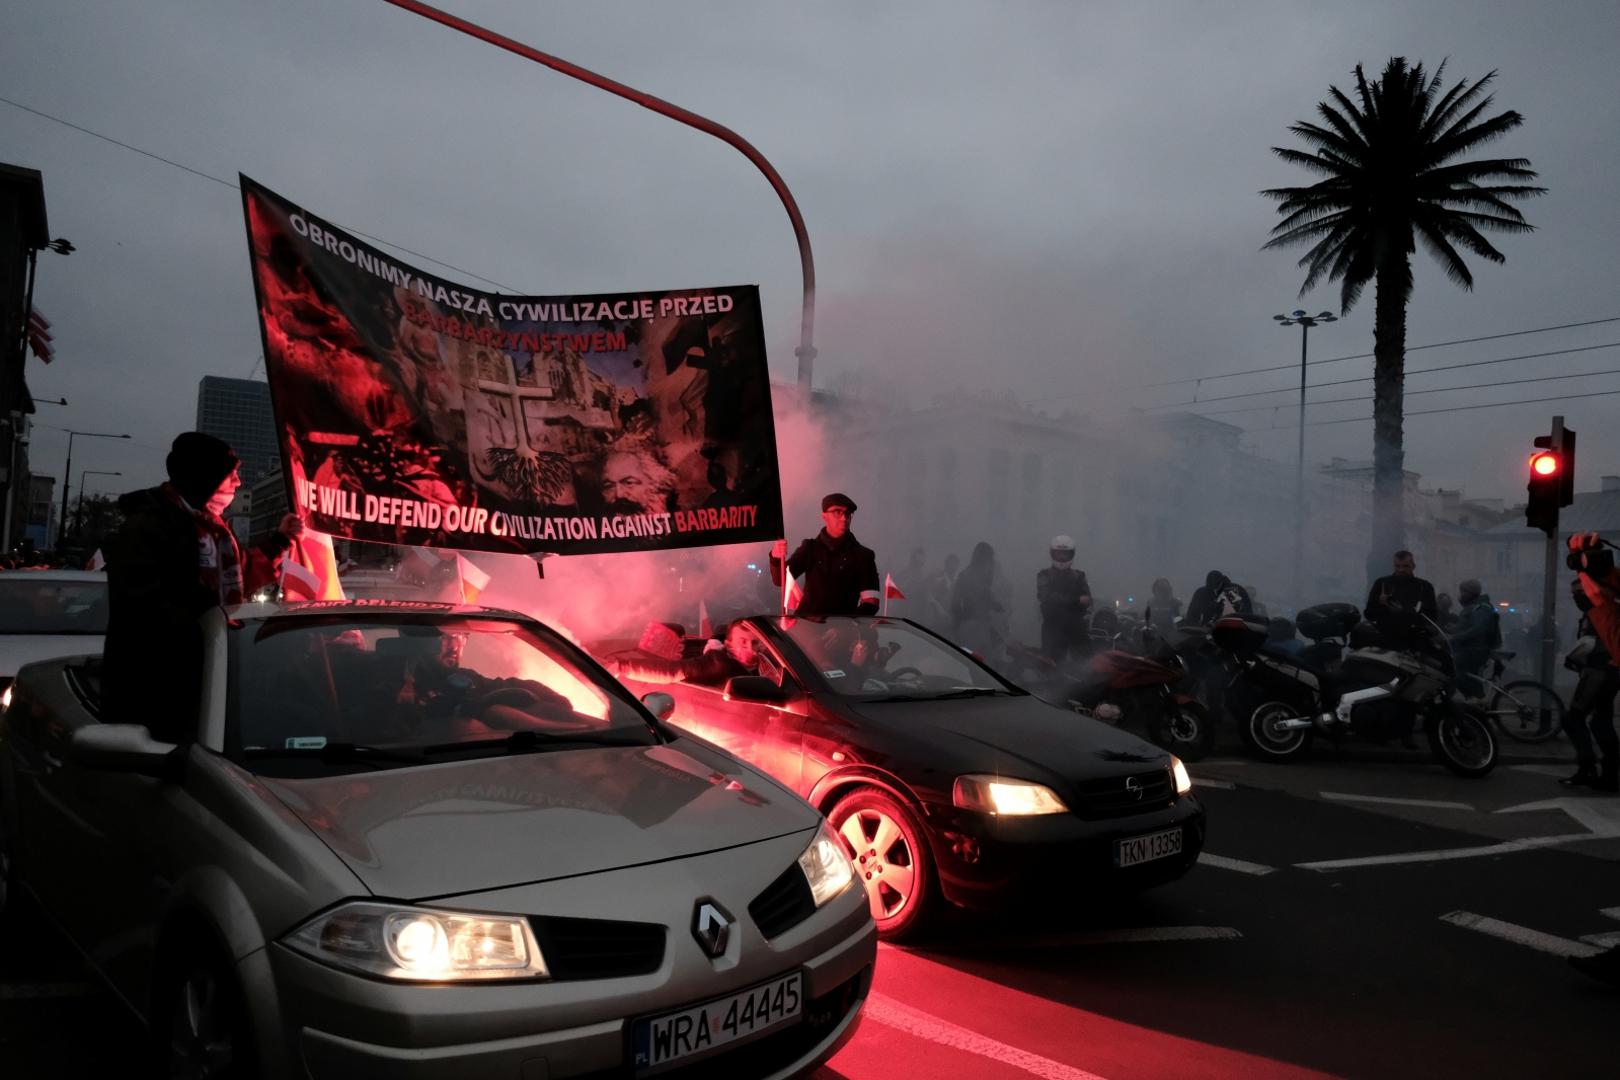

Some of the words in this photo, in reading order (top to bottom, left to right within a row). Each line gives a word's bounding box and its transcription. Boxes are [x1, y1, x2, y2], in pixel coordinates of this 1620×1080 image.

[289, 213, 412, 290] OBRONIMY
[416, 277, 494, 322] NASZĄ
[499, 300, 654, 324] CYWILIZACJĘ
[659, 294, 734, 318] PRZED
[297, 478, 318, 512] WE
[319, 485, 362, 521] WILL
[364, 494, 442, 530] DEFEND
[444, 506, 489, 534] OUR
[489, 510, 598, 540] CIVILIZATION
[600, 512, 672, 539] AGAINST
[673, 504, 759, 533] BARBARITY
[1122, 840, 1145, 864] TKN
[1150, 831, 1181, 857] 13358
[654, 1010, 710, 1061] WRA
[723, 977, 798, 1034] 44445
[635, 1053, 649, 1065] PL
